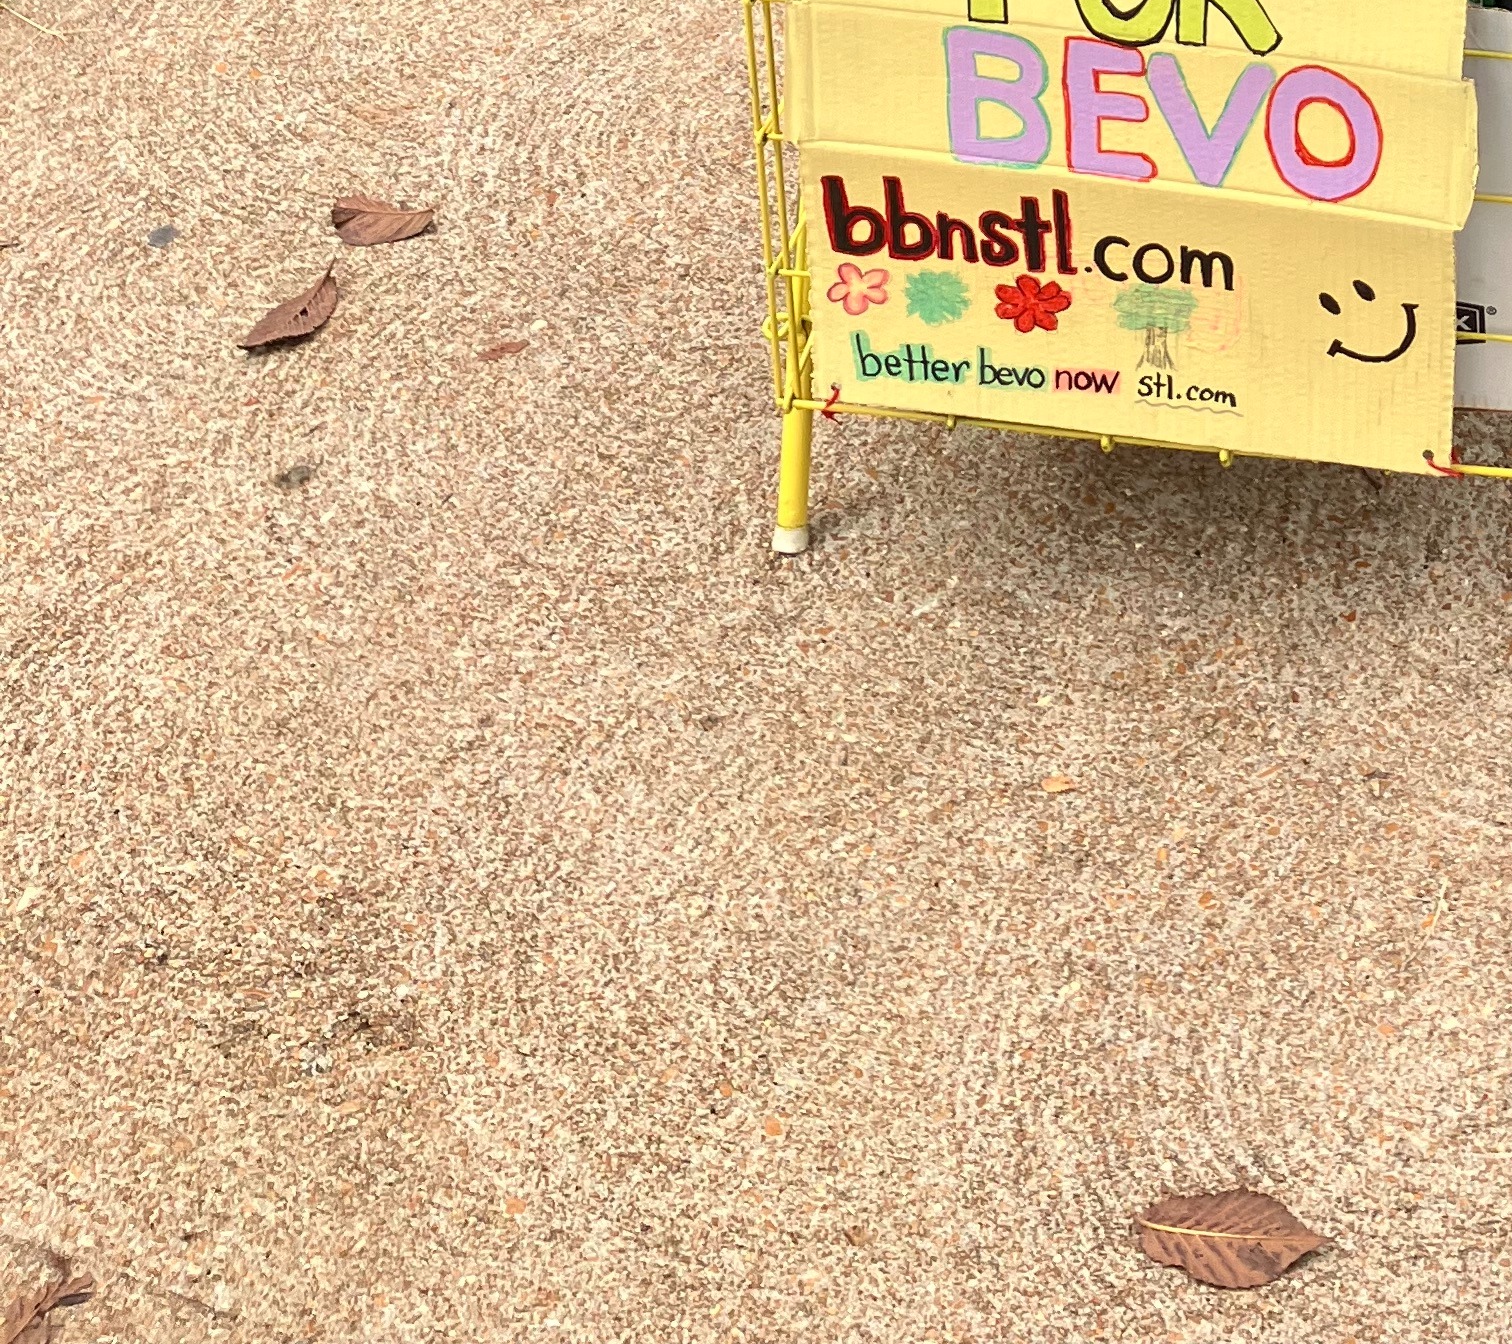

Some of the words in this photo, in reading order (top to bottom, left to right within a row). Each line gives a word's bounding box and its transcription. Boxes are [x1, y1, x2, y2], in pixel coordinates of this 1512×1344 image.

[942, 25, 1383, 202] BEVO
[820, 175, 1236, 291] bbnstl.com
[855, 332, 971, 384] better
[979, 345, 1047, 389] bevo
[1054, 367, 1121, 394] now
[1136, 372, 1238, 408] stl.com
